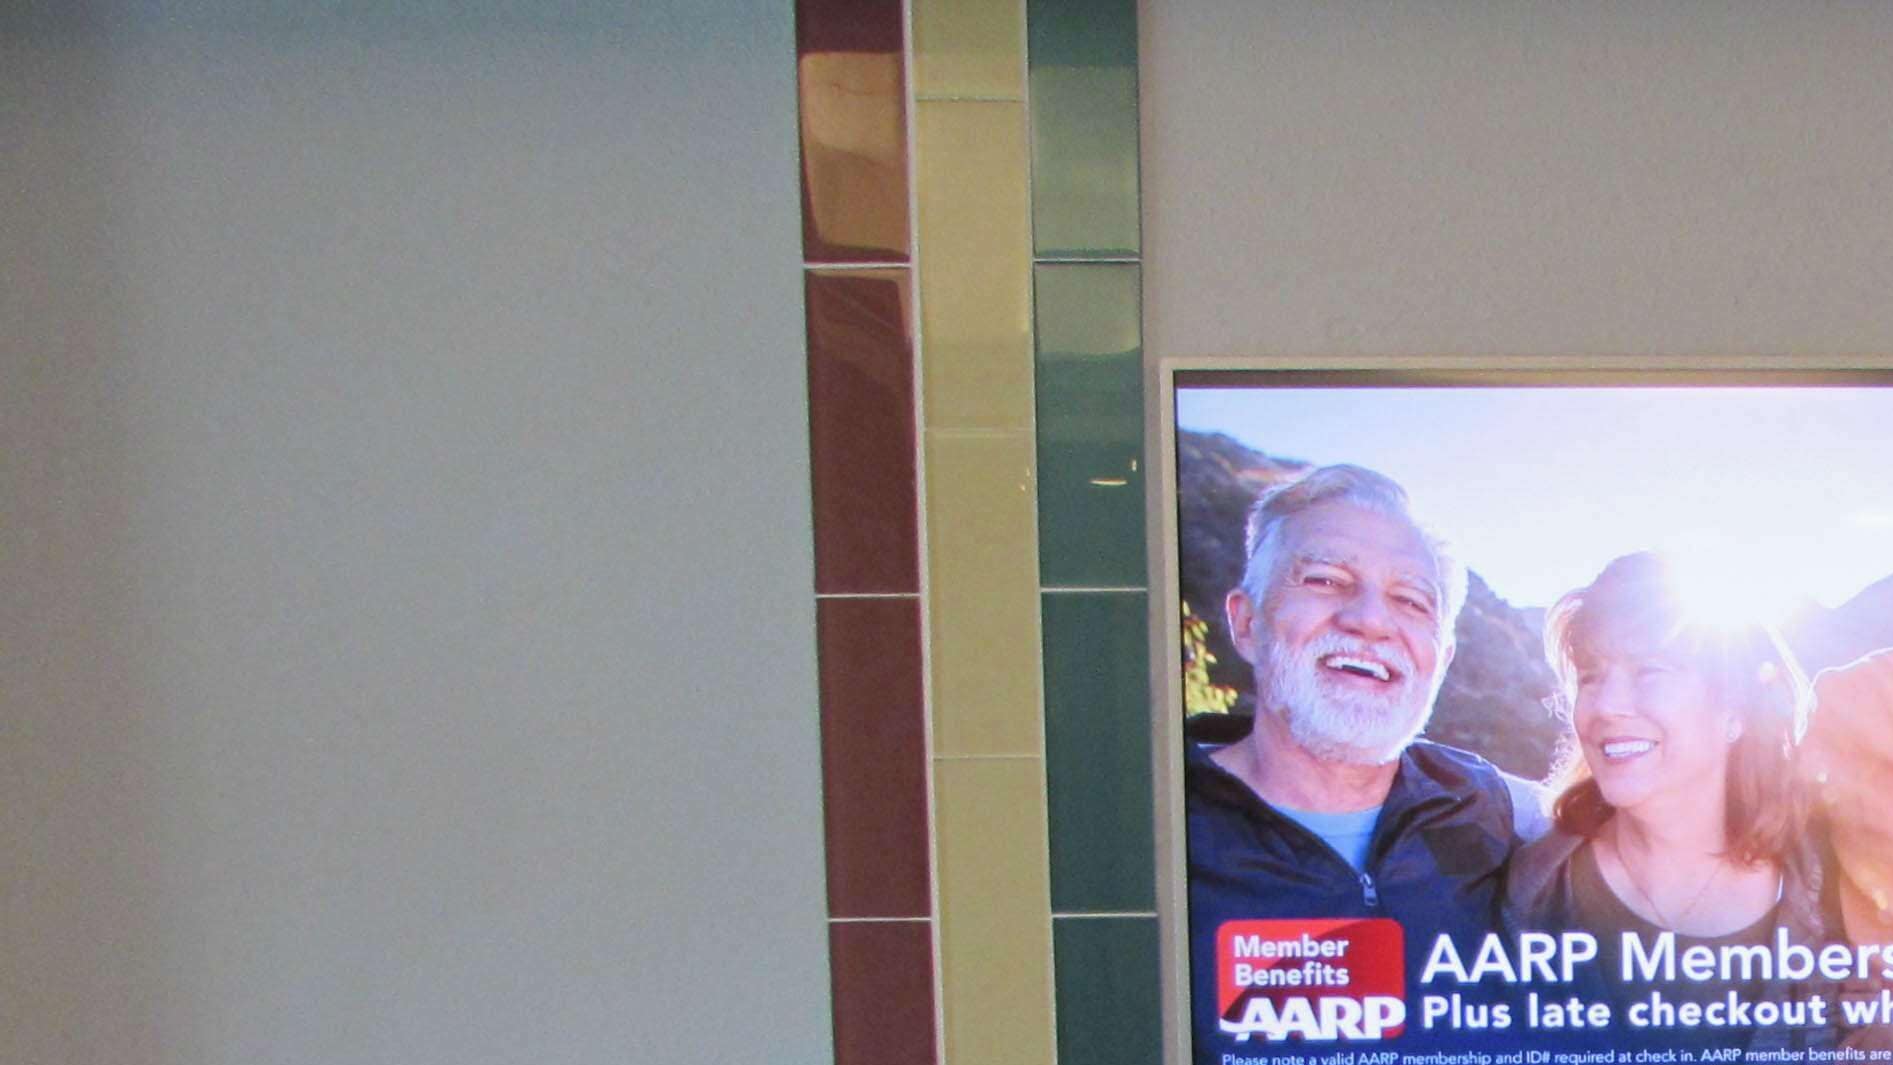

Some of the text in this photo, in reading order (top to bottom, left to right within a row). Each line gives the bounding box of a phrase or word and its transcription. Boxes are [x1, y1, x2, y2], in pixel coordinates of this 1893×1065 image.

[1233, 934, 1349, 959] Member
[1421, 932, 1598, 985] AARP
[1235, 962, 1349, 987] Benefits
[1221, 997, 1406, 1041] AARP
[1423, 993, 1512, 1029] Plus
[1529, 992, 1611, 1028] late
[1628, 991, 1827, 1027] checkout
[1309, 1057, 1316, 1065] a
[1321, 1052, 1354, 1065] valid
[1358, 1052, 1398, 1065] AARP
[1496, 1050, 1522, 1064] and
[1527, 1051, 1550, 1064] ID#
[1619, 1051, 1632, 1063] at
[1636, 1049, 1676, 1063] check
[1680, 1049, 1697, 1062] in.
[1701, 1049, 1742, 1062] AARP
[1745, 1048, 1804, 1061] member
[1809, 1046, 1865, 1061] benefits
[1869, 1050, 1891, 1060] are
